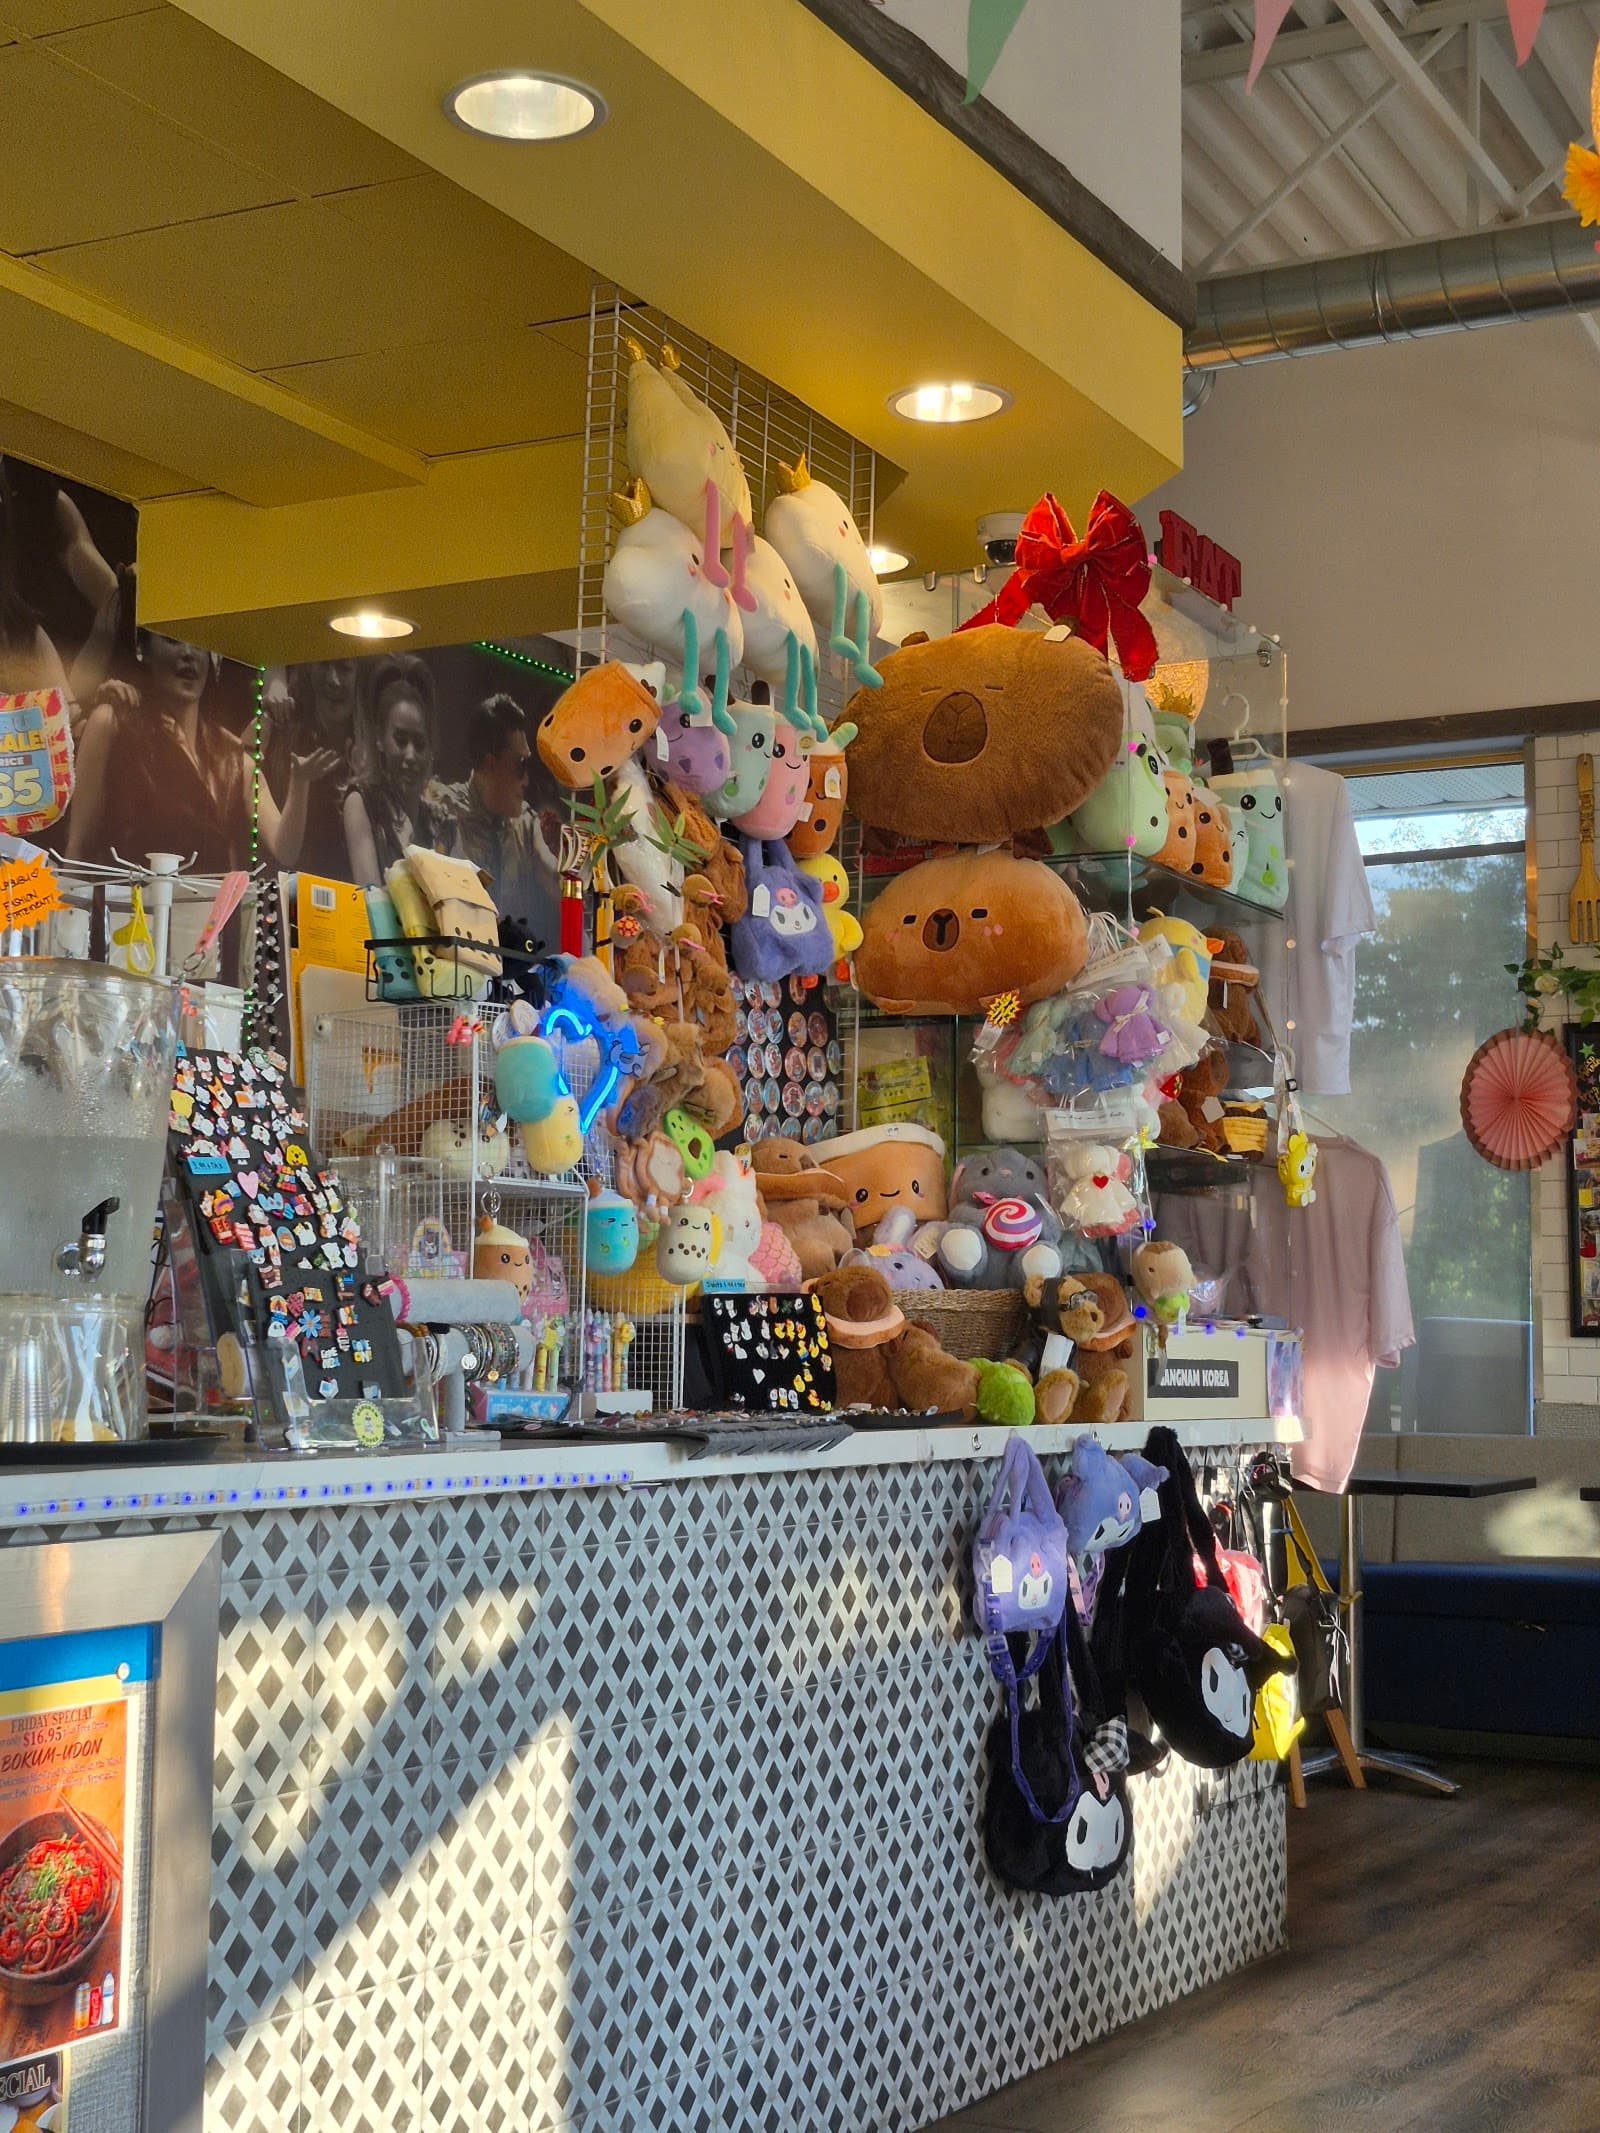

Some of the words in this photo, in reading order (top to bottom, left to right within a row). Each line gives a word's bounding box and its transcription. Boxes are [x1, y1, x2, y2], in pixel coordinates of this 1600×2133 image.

[1201, 1370, 1229, 1387] KOREA
[11, 1713, 49, 1733] FRIDAY
[52, 1707, 94, 1726] SPECIAL
[23, 1727, 62, 1746] $16.95
[1, 1738, 103, 1773] BOKUM-UDON
